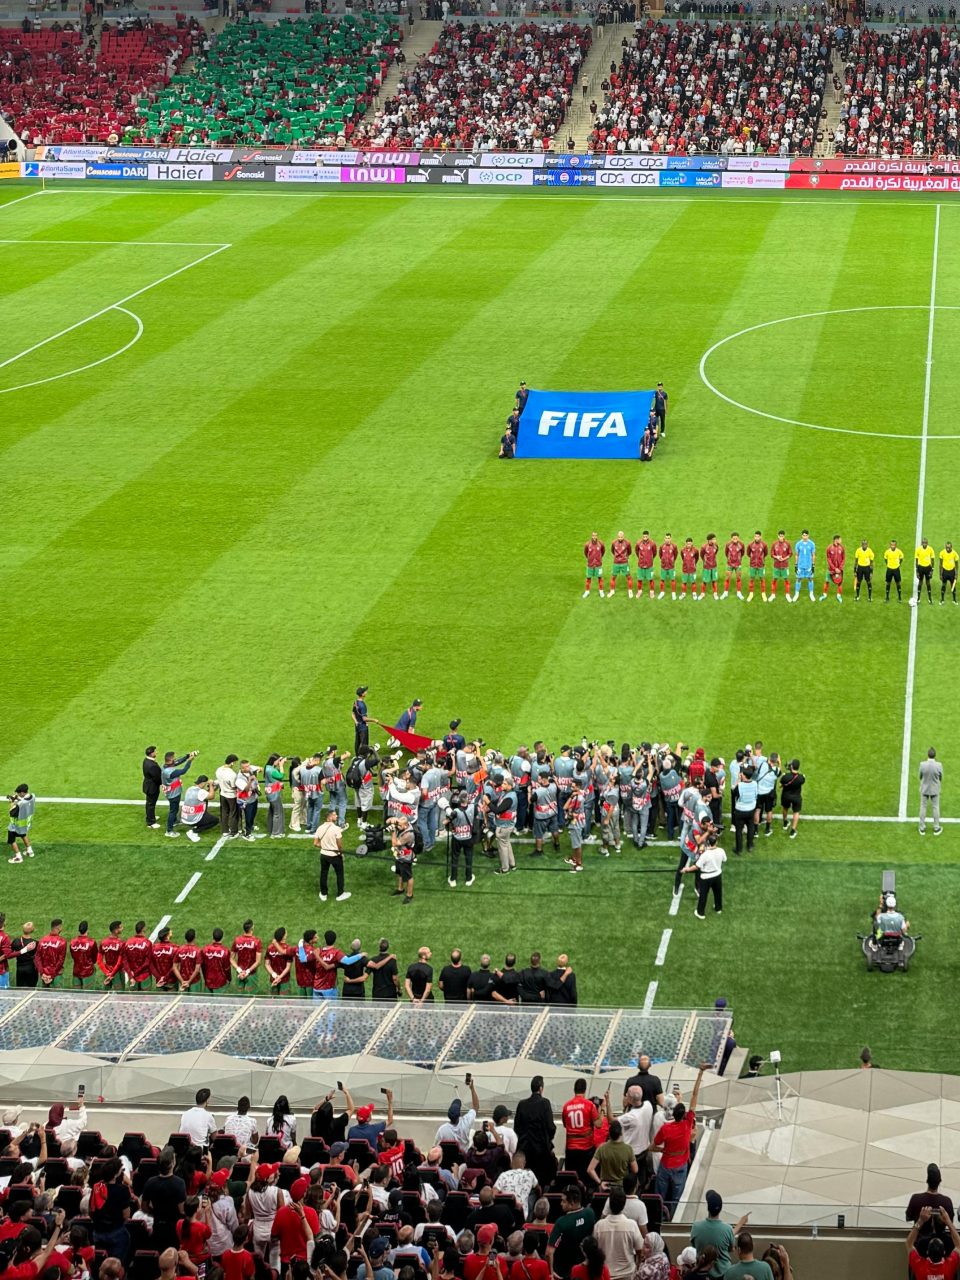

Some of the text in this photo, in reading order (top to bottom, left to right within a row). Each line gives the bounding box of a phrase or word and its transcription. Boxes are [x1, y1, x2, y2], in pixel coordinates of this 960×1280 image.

[176, 150, 224, 161] Haier
[123, 168, 148, 176] DARI
[158, 166, 203, 179] Haier
[844, 162, 876, 172] القدم
[878, 162, 902, 172] لكرة
[350, 169, 395, 181] inwi
[600, 173, 656, 184] CDG CDG
[840, 178, 873, 190] القدم
[876, 178, 900, 190] لكرة
[903, 177, 949, 190] المغربية
[538, 410, 627, 437] FIFA
[568, 1110, 584, 1128] 10
[392, 1158, 404, 1174] 10
[576, 1218, 585, 1227] JAD
